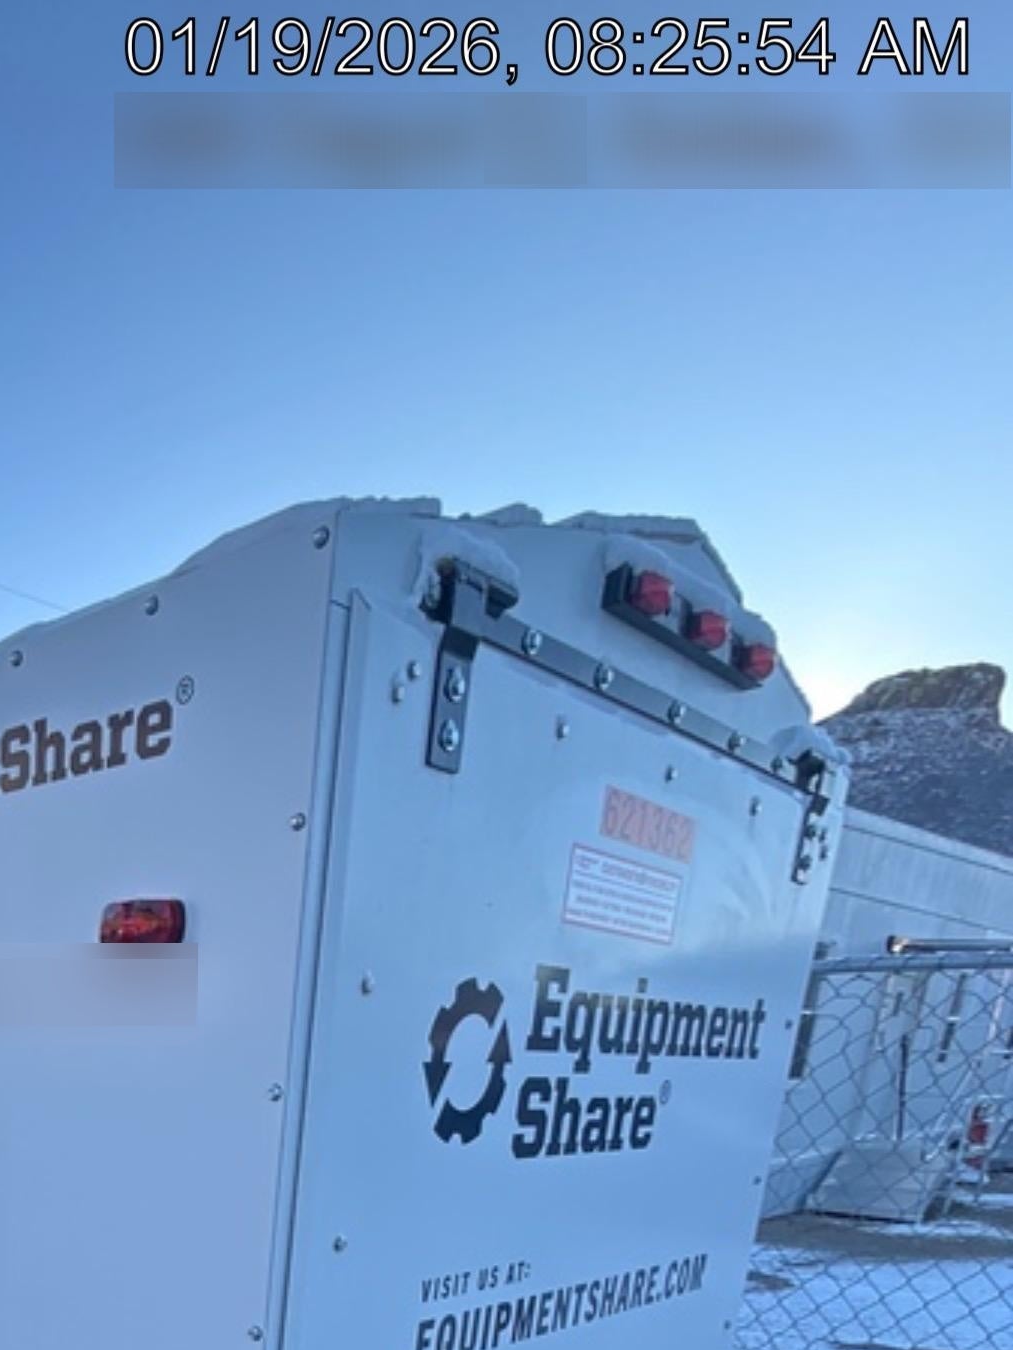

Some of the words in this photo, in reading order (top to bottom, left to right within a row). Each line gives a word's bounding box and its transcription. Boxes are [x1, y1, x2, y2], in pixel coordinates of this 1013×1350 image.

[525, 962, 767, 1075] Equipment
[421, 1271, 471, 1303] VISIT
[477, 1265, 499, 1292] US
[505, 1260, 532, 1285] AT:
